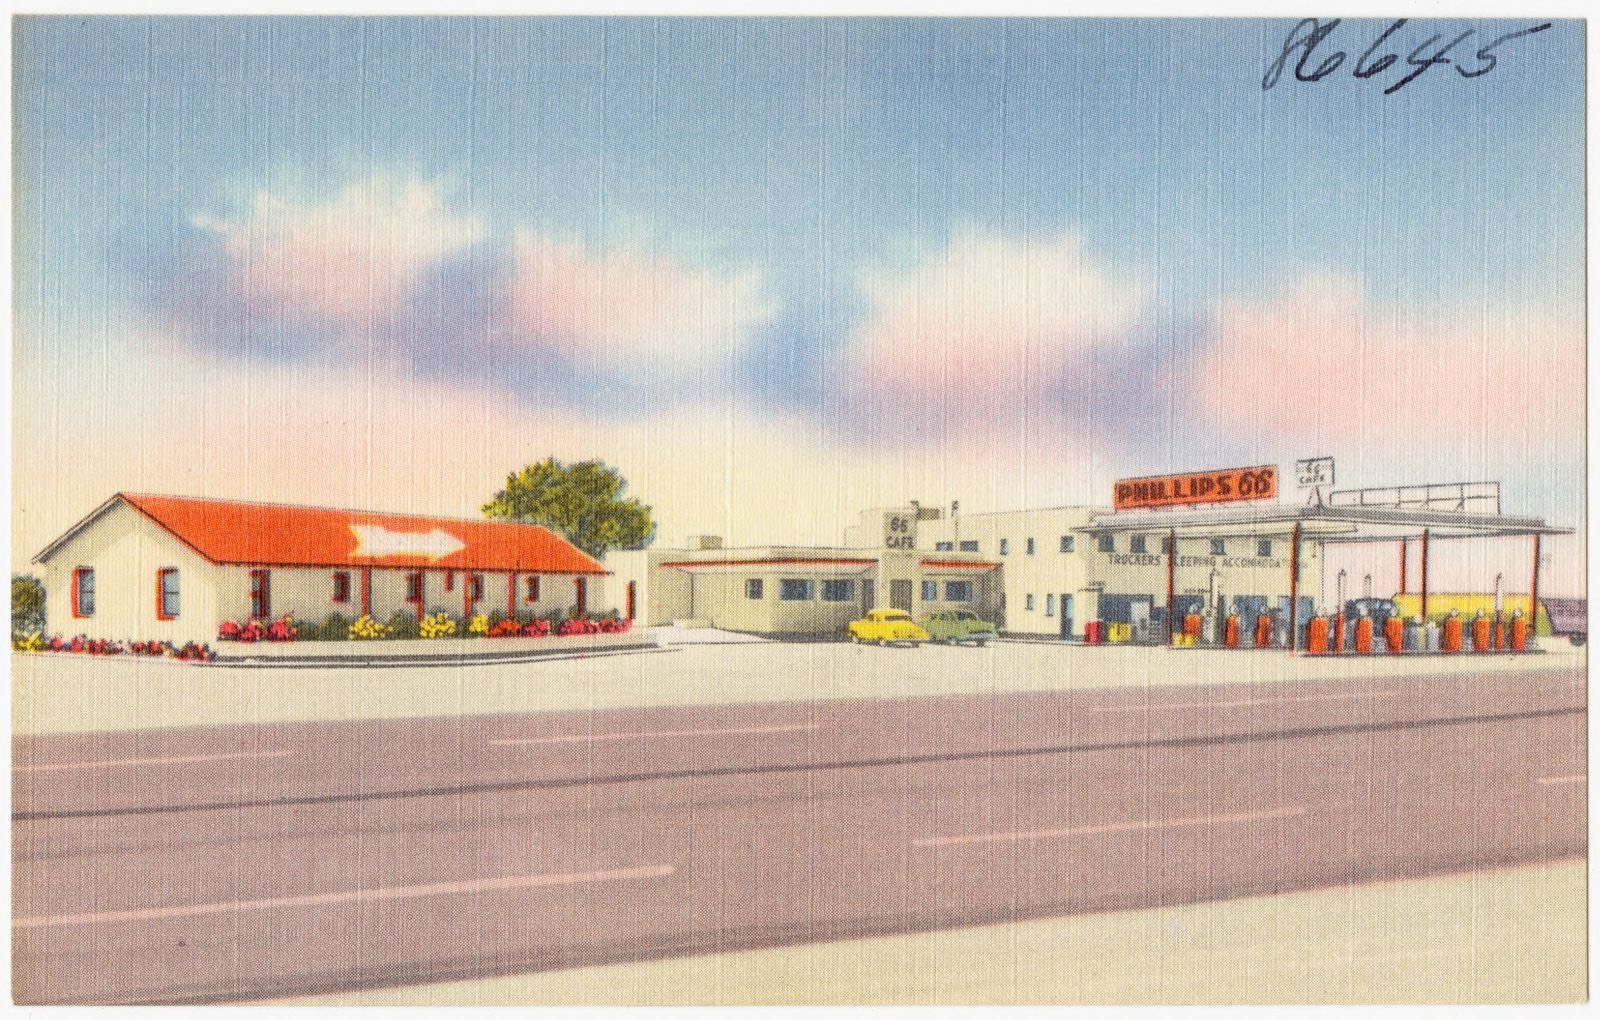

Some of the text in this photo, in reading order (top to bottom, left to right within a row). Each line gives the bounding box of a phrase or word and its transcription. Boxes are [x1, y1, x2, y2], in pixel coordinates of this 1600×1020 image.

[1262, 17, 1551, 94] 86645
[1118, 469, 1273, 500] PHILLIPS 66
[890, 517, 908, 533] 66
[885, 536, 915, 550] CAFE
[1108, 553, 1161, 566] TRUCKERS
[1168, 555, 1216, 567] LEEPING
